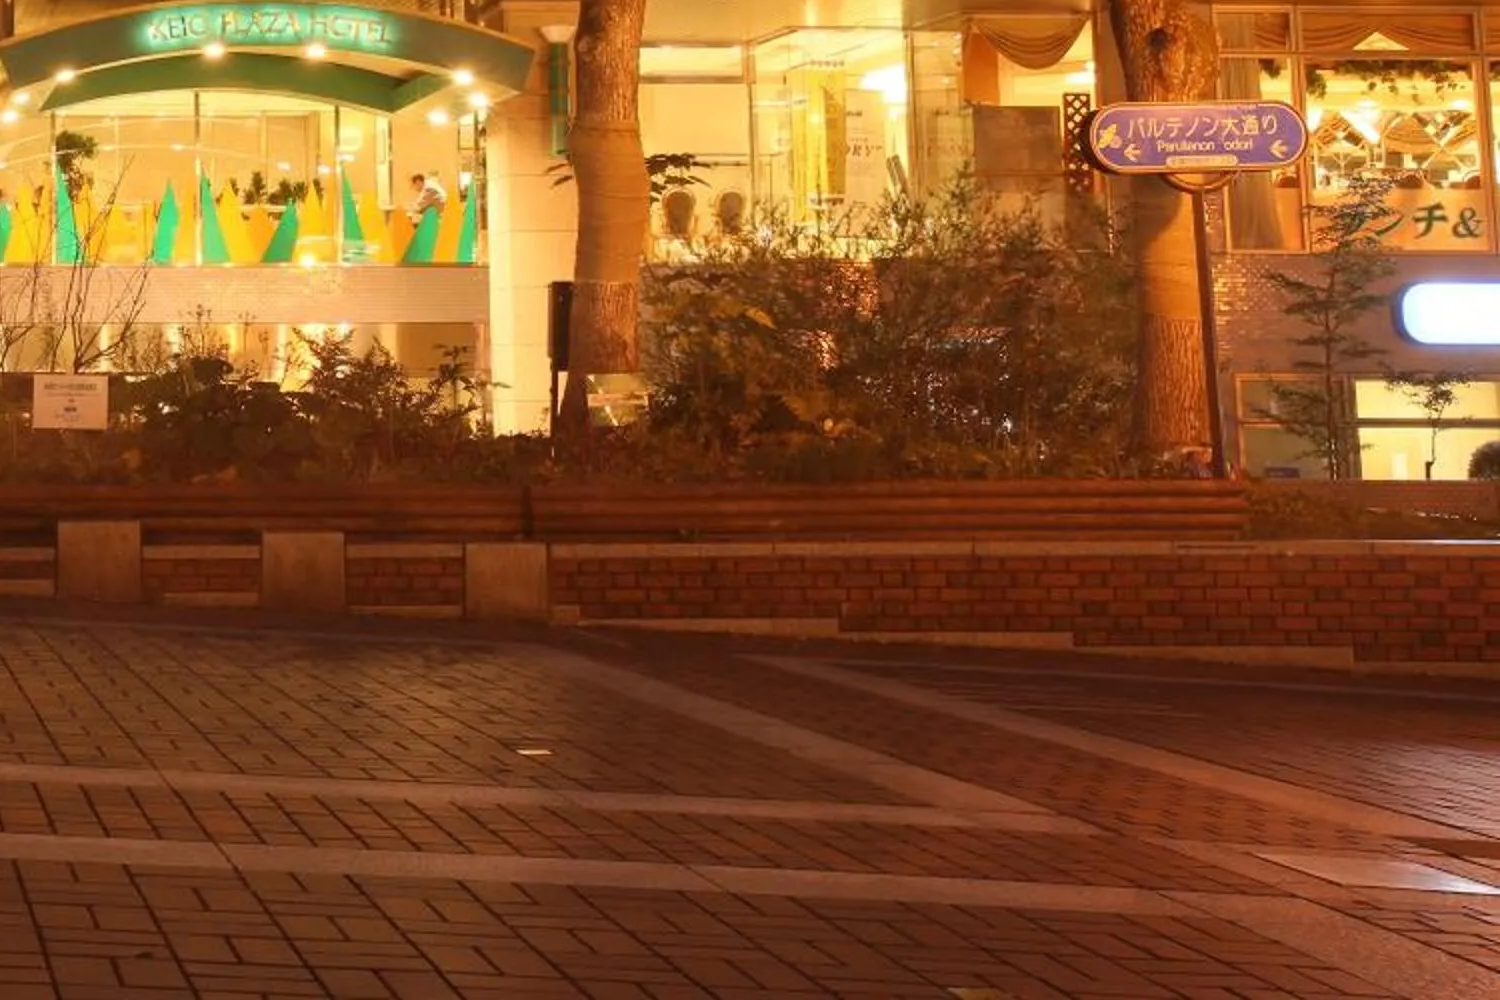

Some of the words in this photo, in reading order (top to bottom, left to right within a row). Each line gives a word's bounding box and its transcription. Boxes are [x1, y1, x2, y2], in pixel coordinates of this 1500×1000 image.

[148, 13, 209, 41] KEIO
[219, 9, 301, 36] PLAZA
[305, 12, 393, 44] HOTEL
[1127, 114, 1278, 139] パルテノン大通り
[1223, 138, 1253, 150] odori
